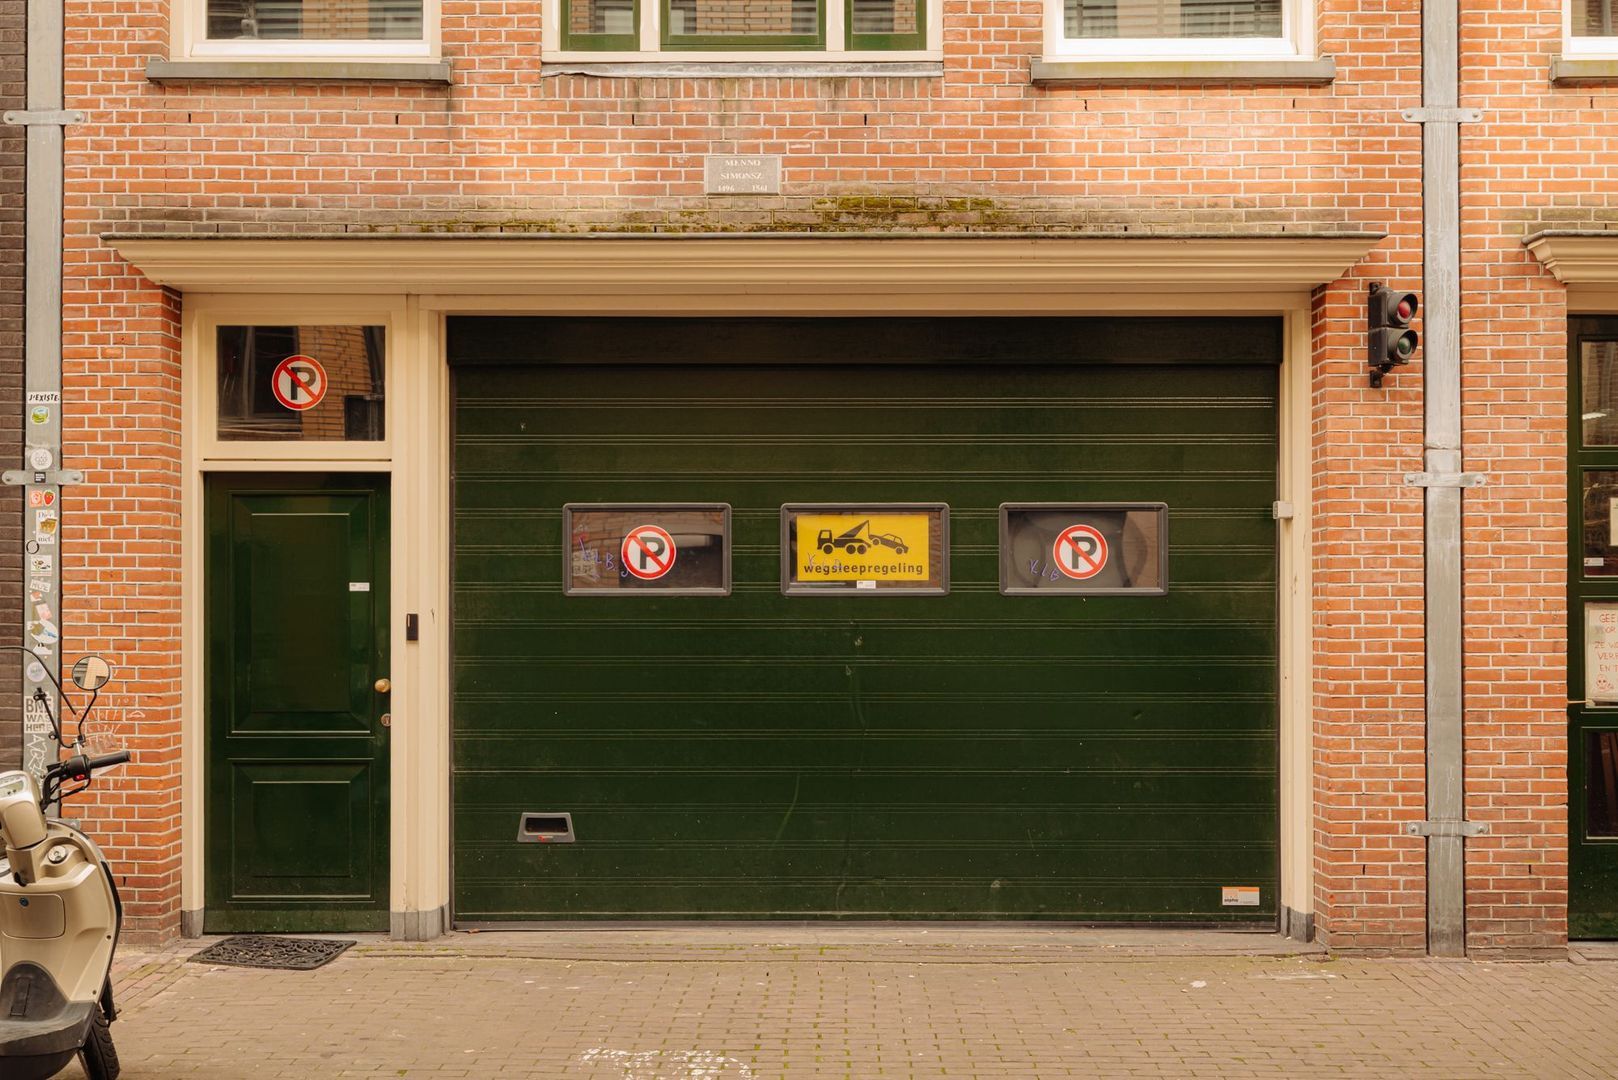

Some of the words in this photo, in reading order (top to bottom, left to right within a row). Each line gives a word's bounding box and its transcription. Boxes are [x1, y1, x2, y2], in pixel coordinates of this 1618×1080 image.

[725, 159, 761, 167] MENNO
[720, 172, 762, 180] SIMONSZ
[717, 184, 735, 192] 1496
[751, 184, 768, 192] 1561
[291, 367, 316, 400] P
[639, 536, 666, 570] P
[1071, 536, 1097, 569] P
[804, 563, 923, 576] wegsleepregeling
